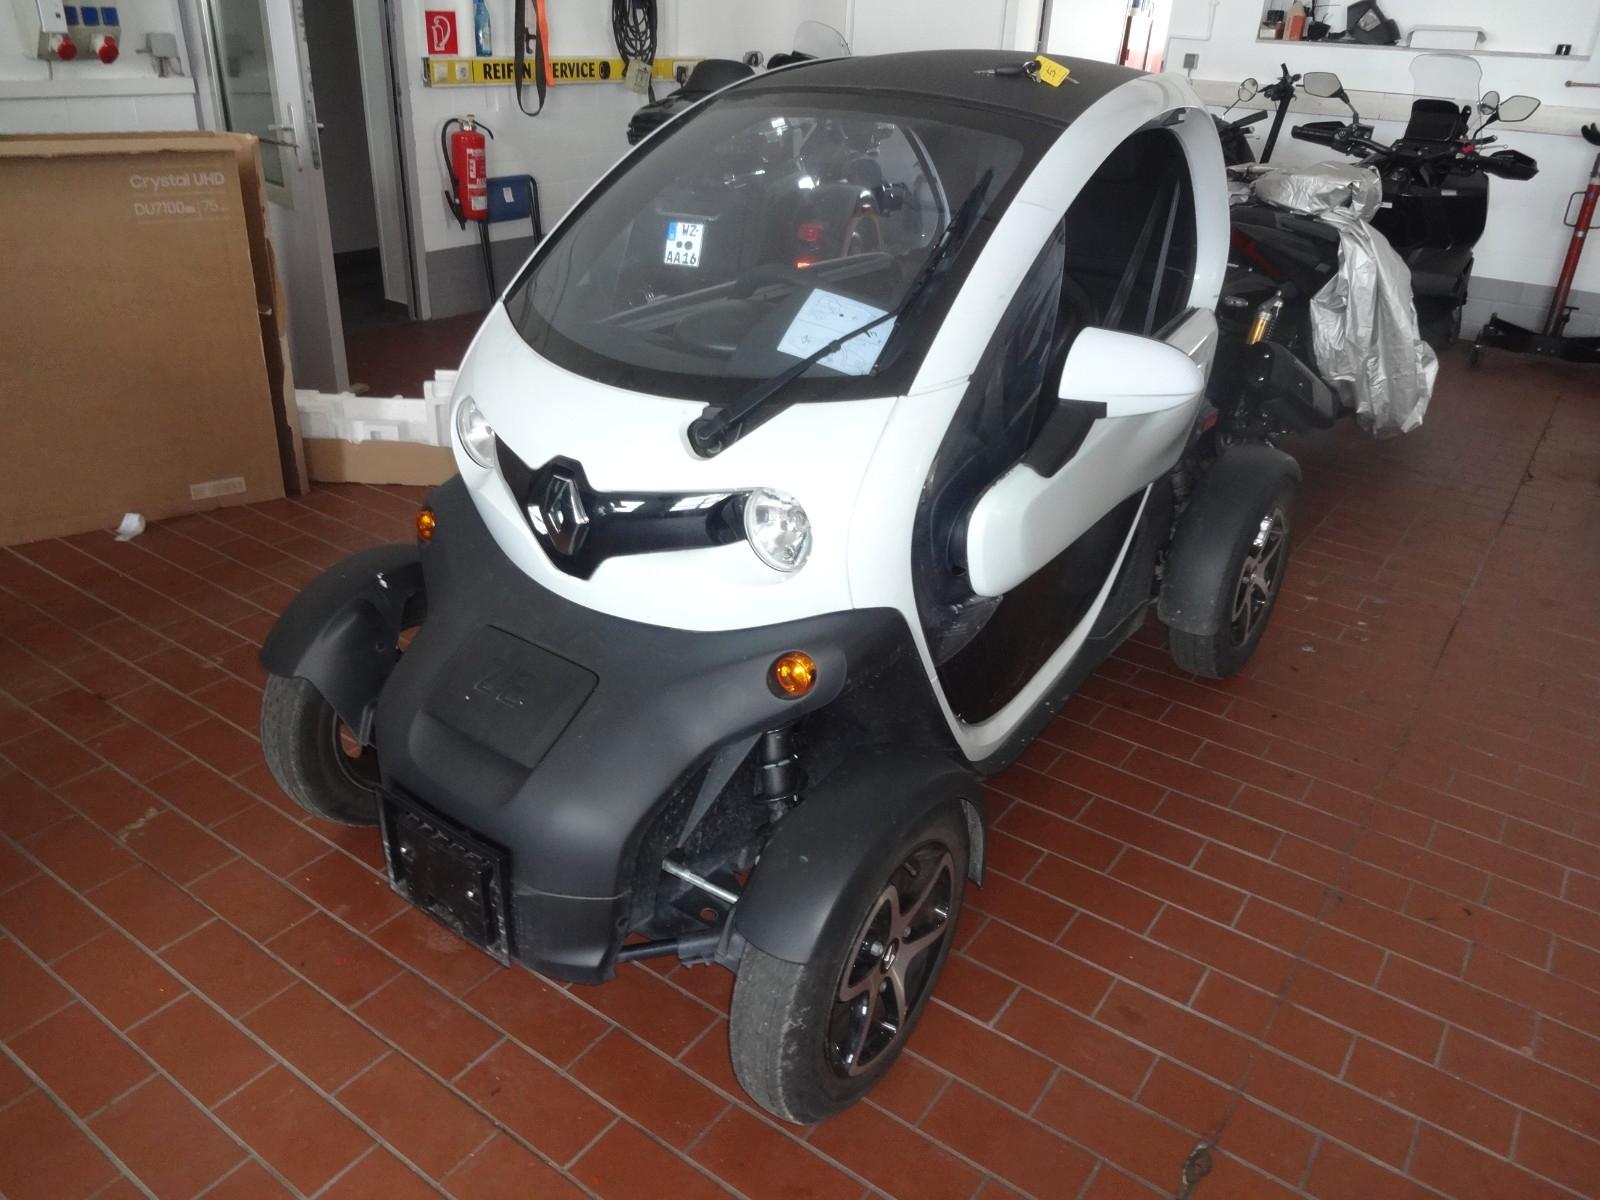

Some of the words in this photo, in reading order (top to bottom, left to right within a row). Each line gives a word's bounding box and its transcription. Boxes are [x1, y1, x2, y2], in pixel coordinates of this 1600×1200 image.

[483, 63, 532, 80] REIFN
[545, 62, 596, 79] ERVICE
[130, 173, 191, 192] Crystal
[193, 172, 225, 186] UHD
[666, 250, 697, 265] AA16
